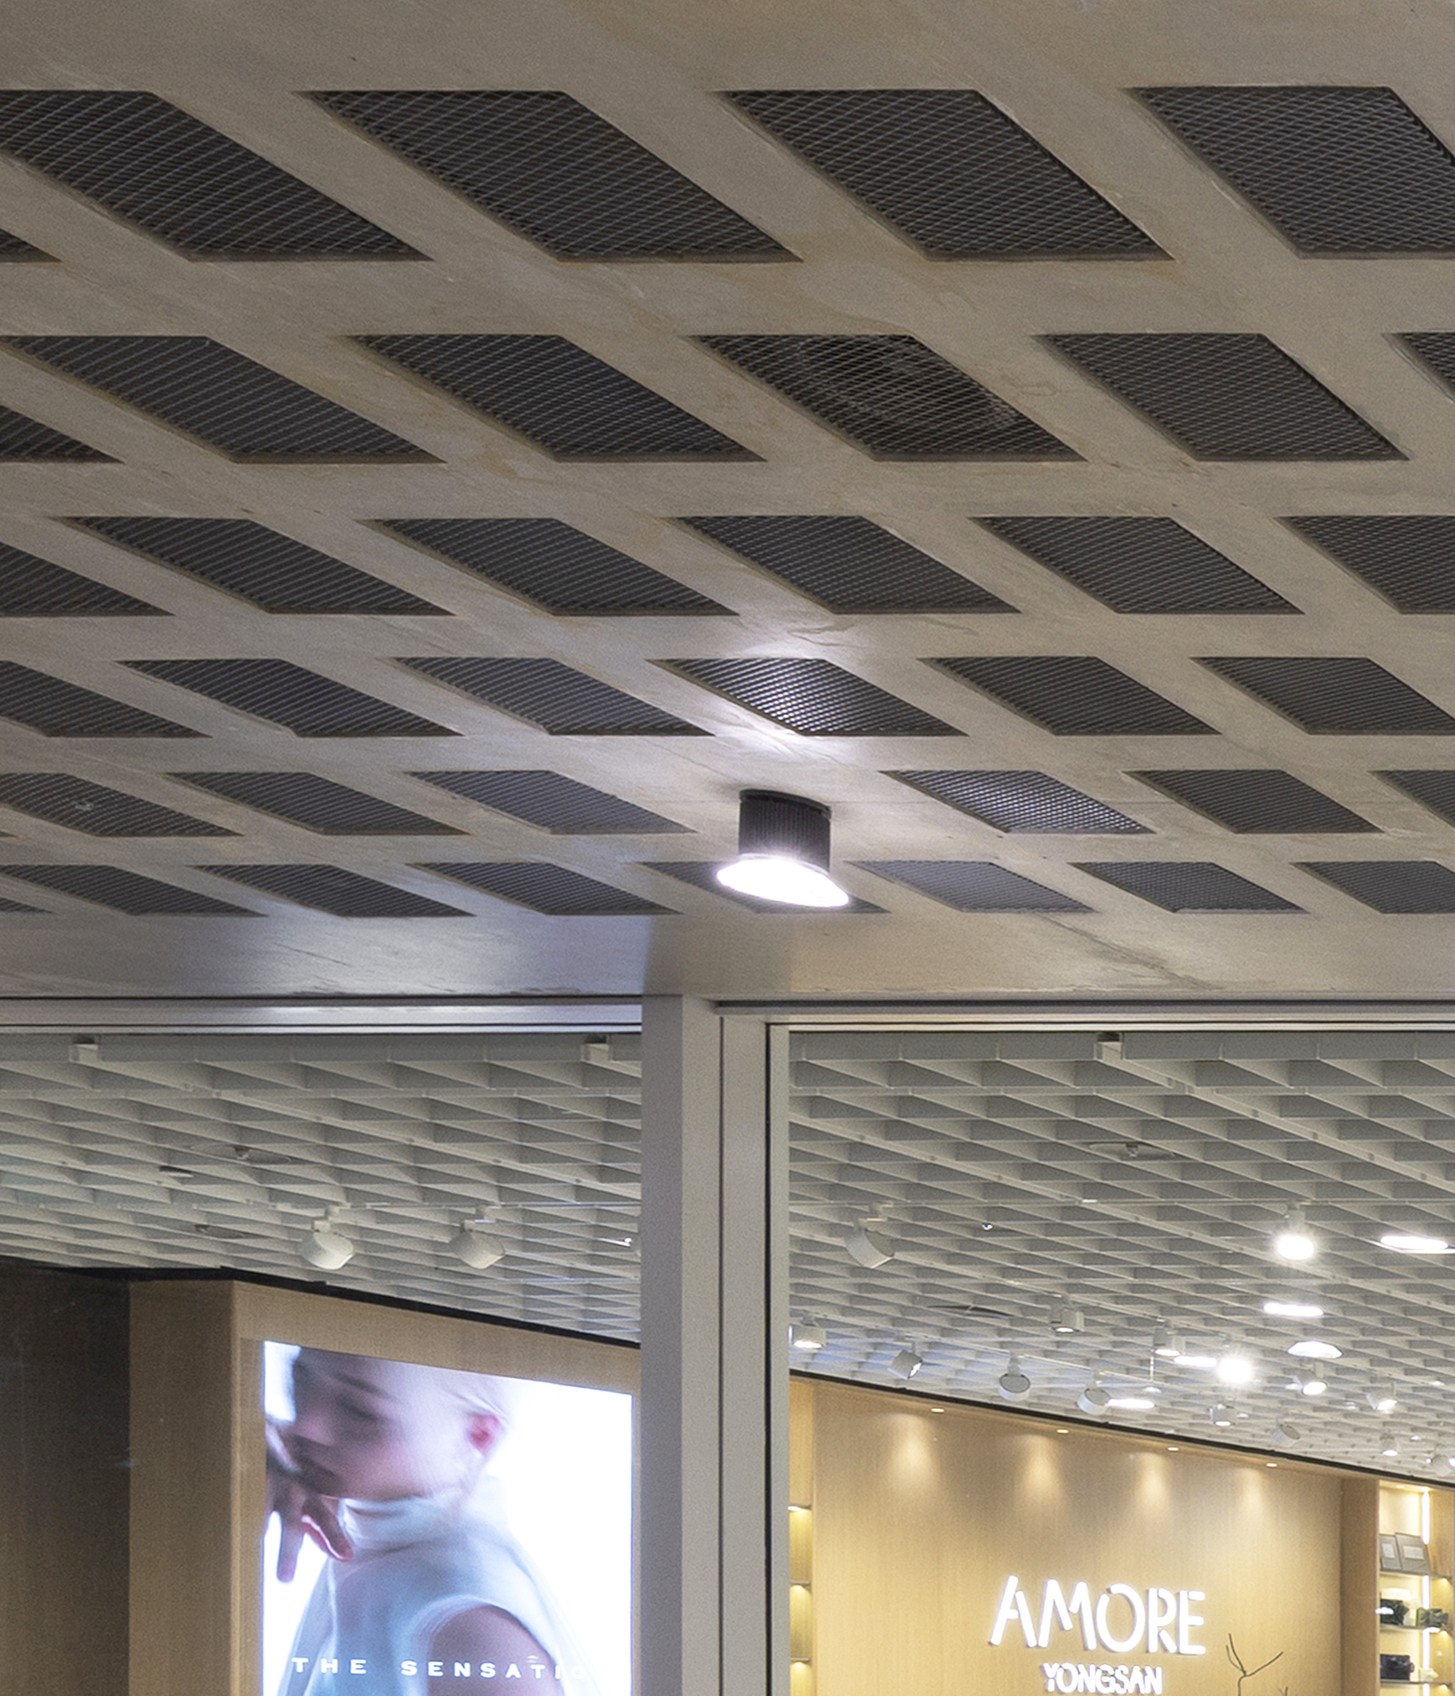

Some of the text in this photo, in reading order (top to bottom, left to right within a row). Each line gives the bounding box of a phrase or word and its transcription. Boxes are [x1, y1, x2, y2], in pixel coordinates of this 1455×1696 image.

[987, 1574, 1207, 1655] AMORE
[291, 1657, 367, 1675] THE
[1042, 1662, 1163, 1695] YONGSAN
